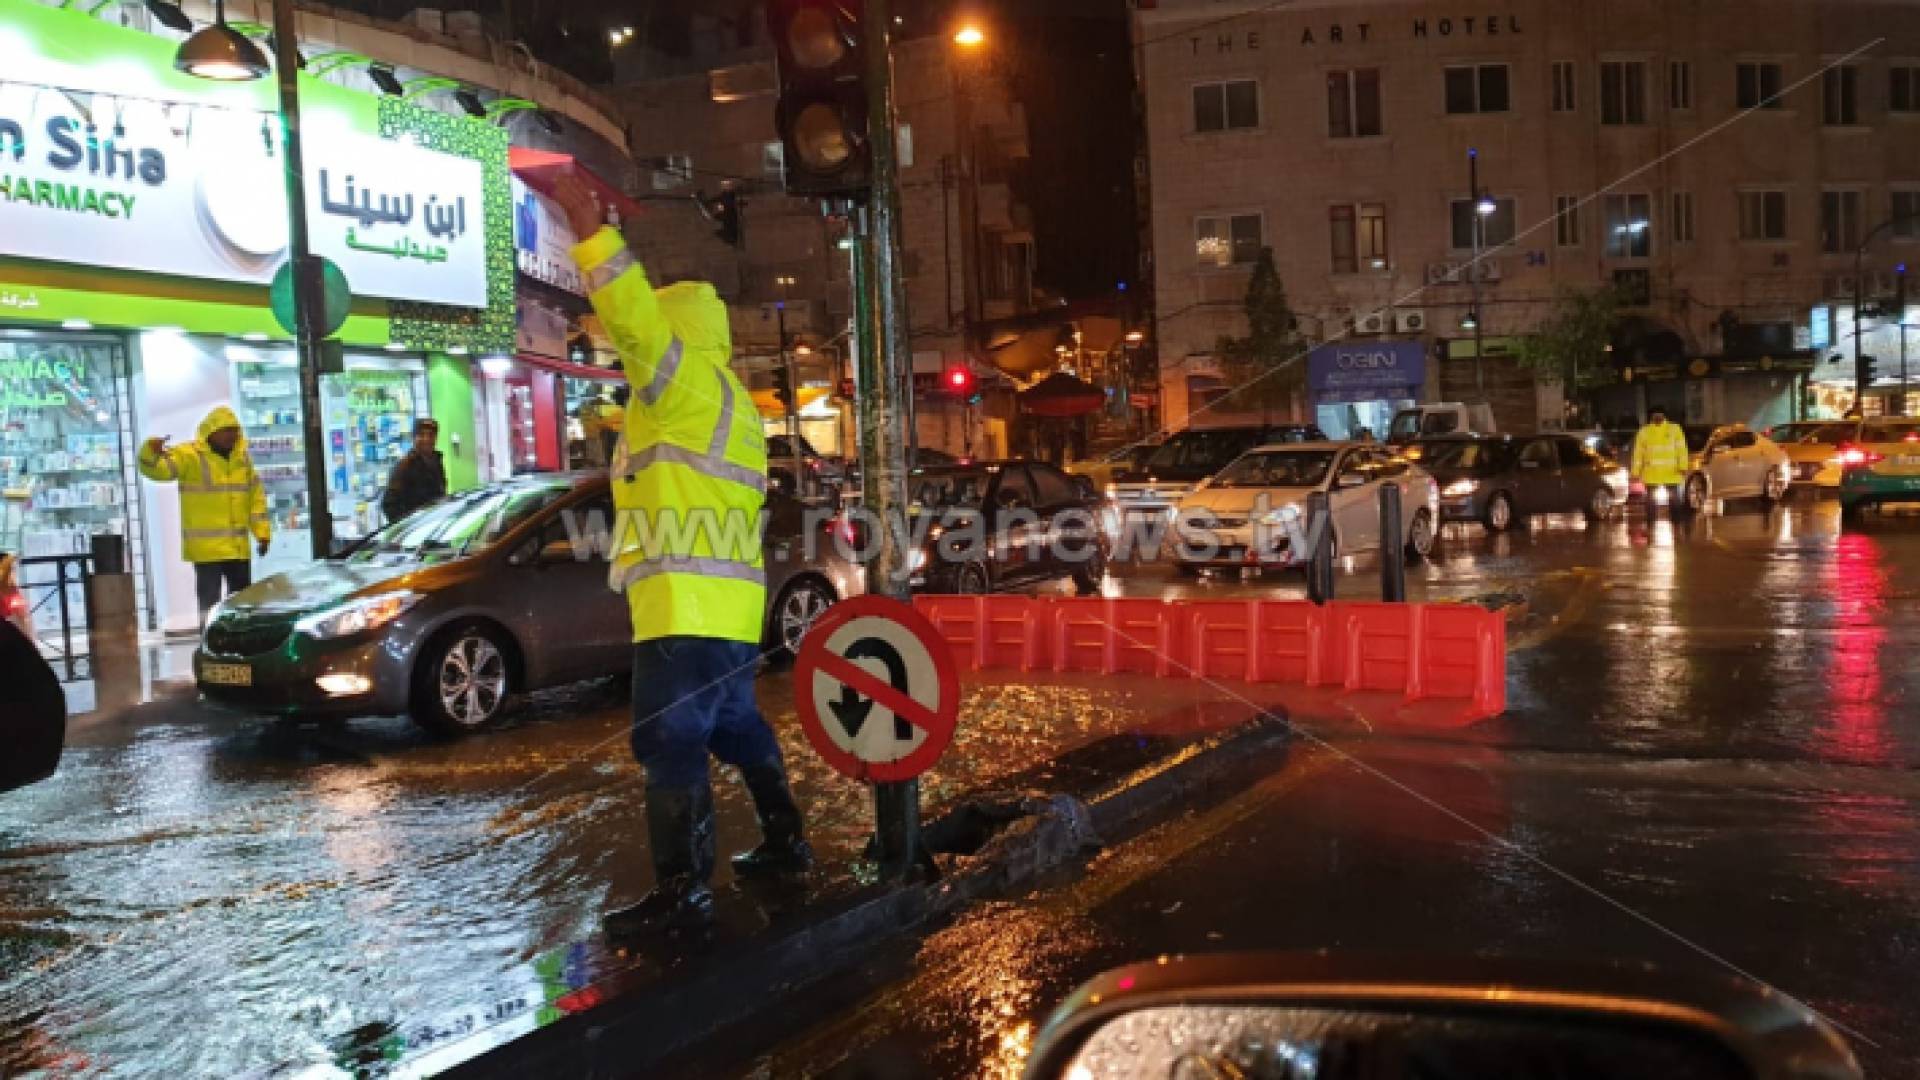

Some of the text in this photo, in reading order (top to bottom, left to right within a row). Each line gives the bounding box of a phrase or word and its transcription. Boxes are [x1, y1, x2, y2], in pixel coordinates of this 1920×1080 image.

[1190, 16, 1522, 55] THE ART HOTEL
[46, 115, 168, 186] Sina
[319, 167, 466, 243] ابن سينا
[345, 226, 448, 264] صيدلية
